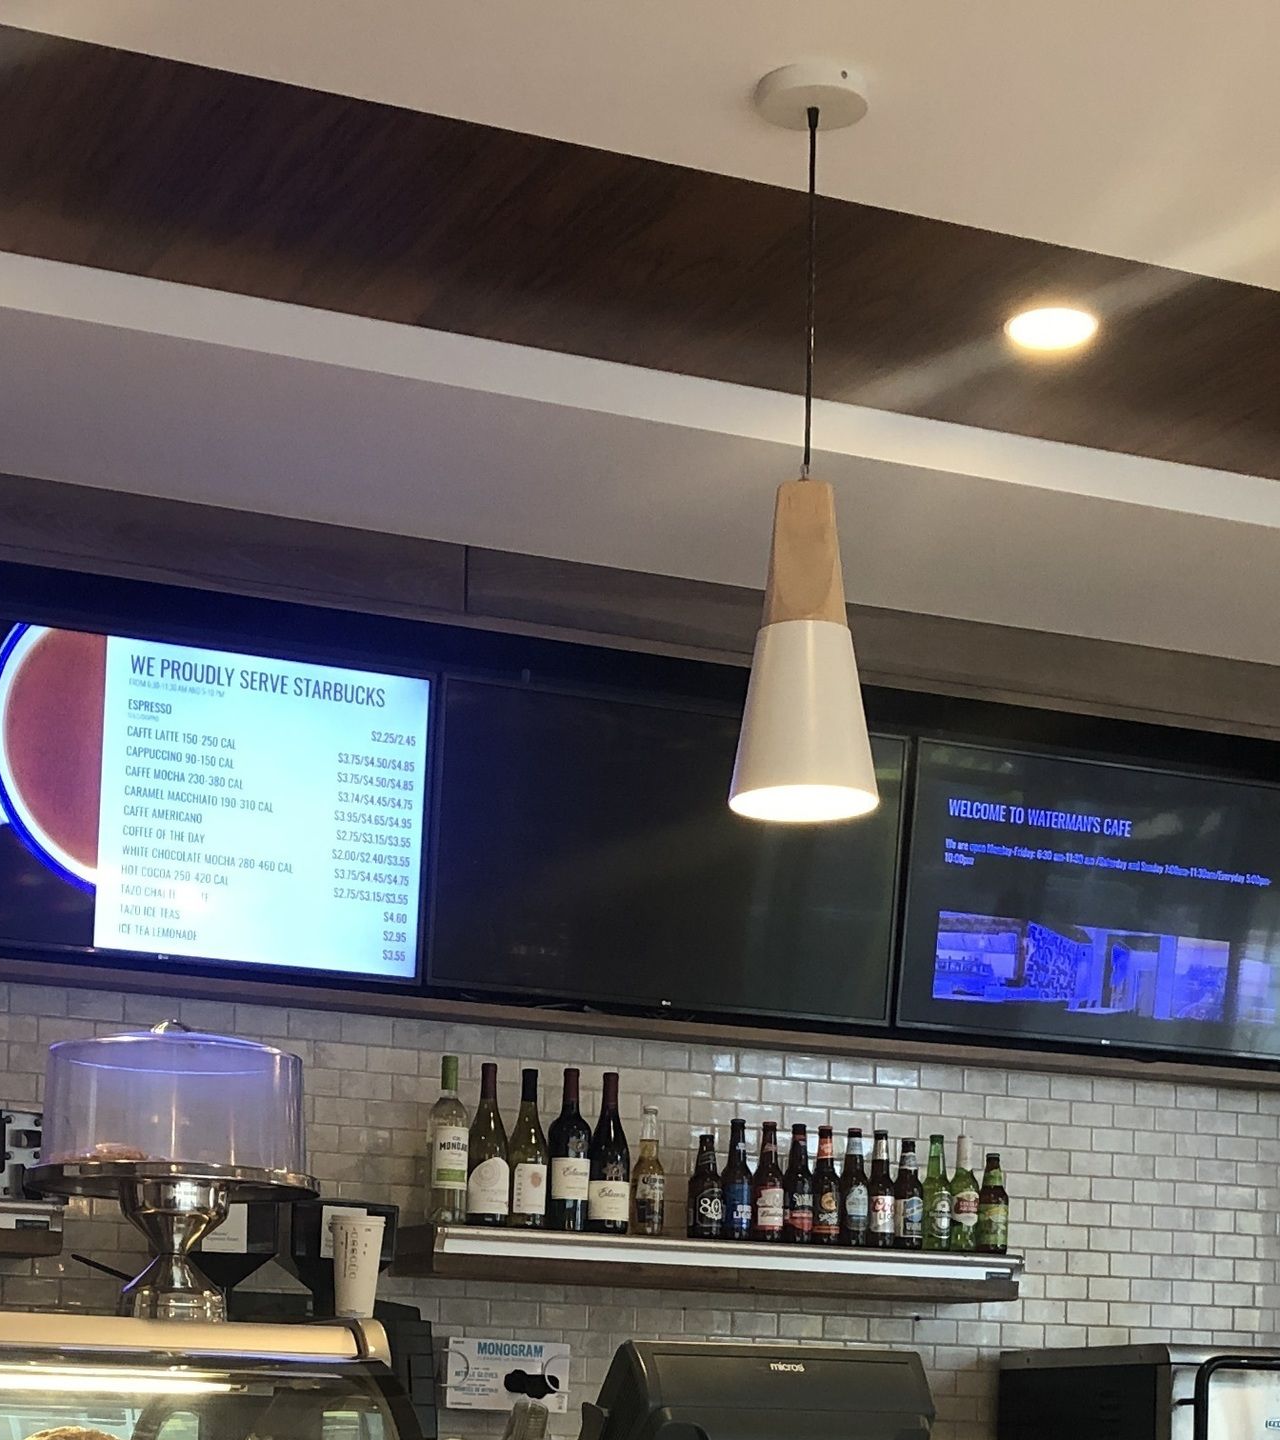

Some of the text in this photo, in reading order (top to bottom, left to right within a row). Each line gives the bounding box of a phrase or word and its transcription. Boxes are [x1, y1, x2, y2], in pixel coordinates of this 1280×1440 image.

[131, 654, 386, 708] WE PROUDLY SERVE STARBUCKS
[128, 699, 417, 747] ESPRESSO $2.25/2.45
[126, 745, 414, 792] CAPPUCCINO 90-150 CAL $3.75/$4.50/$4.85
[127, 726, 153, 739] CAFFE
[155, 729, 179, 743] LATTE
[220, 738, 237, 750] CAL
[337, 752, 415, 773] $3.75/$4.50/$4.85
[125, 765, 151, 779] CAFFE
[153, 768, 185, 782] MOCHA
[188, 773, 226, 788] 230-380
[228, 778, 244, 790] CAL
[123, 804, 411, 848] CAFFE AMERICANO $2.75/$3.15/$3.55
[124, 785, 165, 800] CARAMEL
[167, 790, 218, 806] MACCHIATO
[258, 801, 274, 813] CAL
[334, 810, 412, 829] $3.95/$4.65/$4.95
[949, 798, 1132, 838] WELCOME TO WATERMAN'S CAFE
[156, 828, 166, 840] OF
[170, 830, 185, 842] THE
[188, 832, 206, 845] DAY
[331, 848, 411, 868] $2.00/$2.40/$3.55
[945, 838, 957, 850] We
[121, 864, 138, 875] HOT
[141, 866, 171, 879] COCOA
[214, 874, 229, 886] CAL
[333, 887, 409, 905] $2.75/$3.15/$3.55
[122, 845, 149, 858] WHITE
[151, 848, 202, 864] CHOCOLATE
[204, 853, 236, 867] MOCHA
[277, 862, 294, 874] CAL
[334, 868, 410, 887] $3.75/$4.45/$4.75
[121, 883, 142, 896] TAZO
[118, 923, 406, 962] ICE TEA LEMONADE $3.55
[120, 903, 407, 943] TAZO ICE TEAS $2.95
[477, 1341, 544, 1358] MONOGRAM
[770, 1361, 805, 1372] micros
